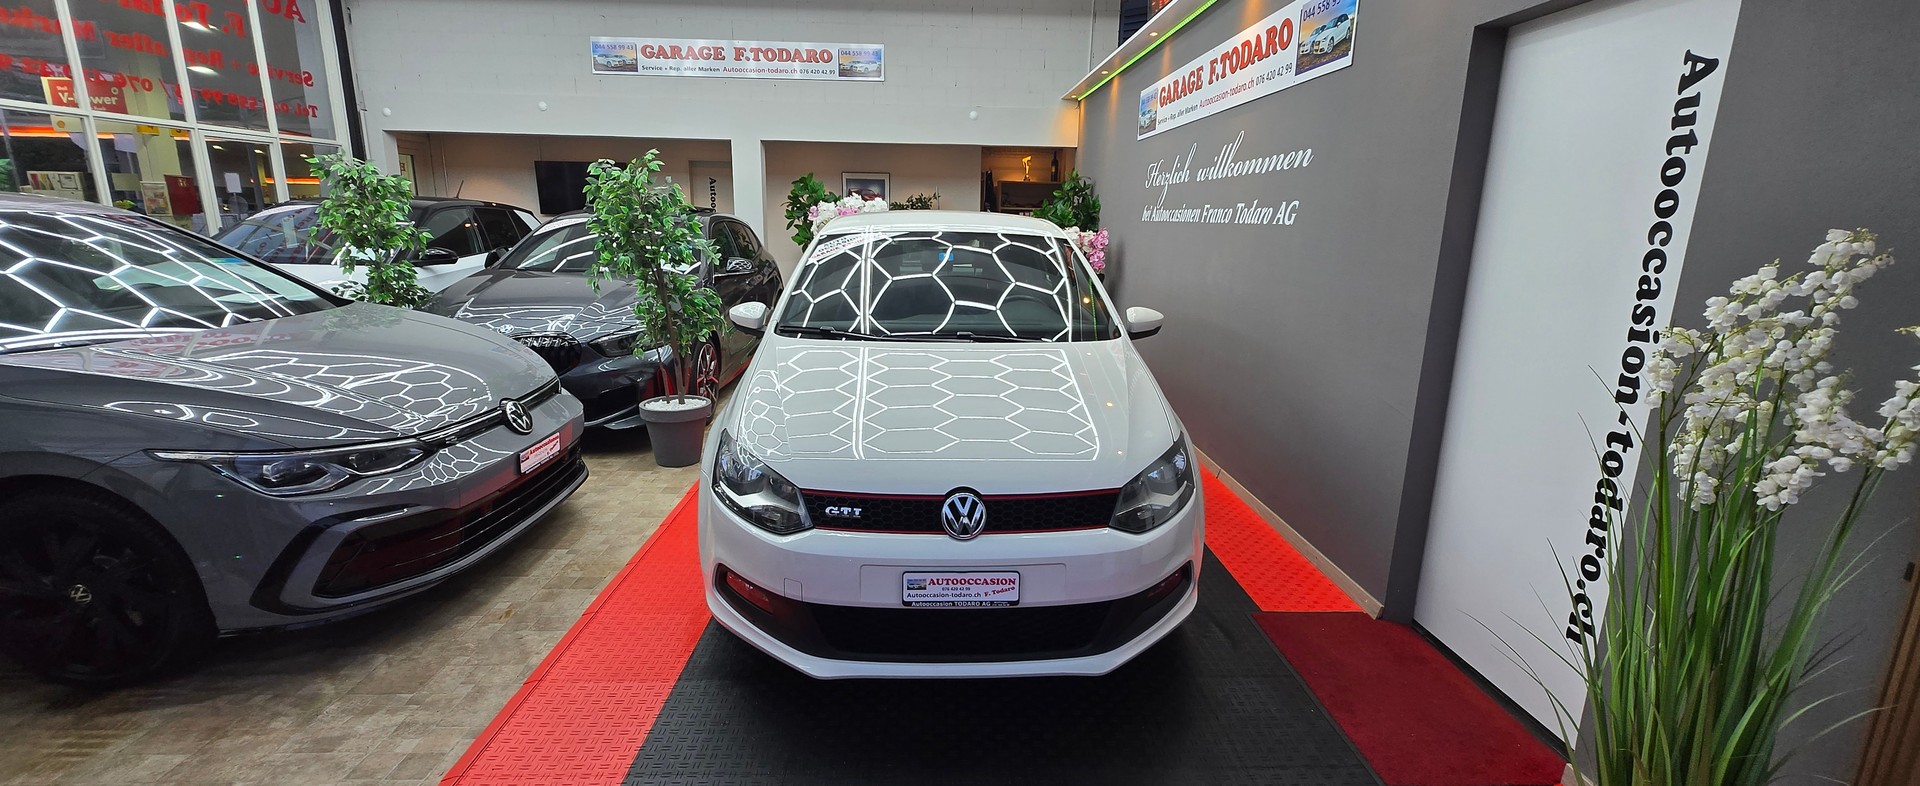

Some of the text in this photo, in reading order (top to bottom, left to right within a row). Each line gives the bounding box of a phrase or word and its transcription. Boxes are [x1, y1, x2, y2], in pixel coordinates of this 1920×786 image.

[1303, 5, 1316, 22] 044
[1316, 0, 1330, 16] 558
[640, 44, 834, 63] GARAGE F.TODARO
[1159, 17, 1294, 108] GARAGE F.TODARO
[1265, 69, 1276, 83] 420
[1276, 66, 1284, 78] 42
[1285, 62, 1293, 75] 99
[1145, 130, 1314, 208] Herzlich willkommen
[1141, 199, 1300, 226] bei Autooccasionen Franco Todaro AG
[825, 505, 862, 518] GTI
[928, 578, 1017, 586] AUTOOCCASION
[992, 586, 1016, 595] Todaro
